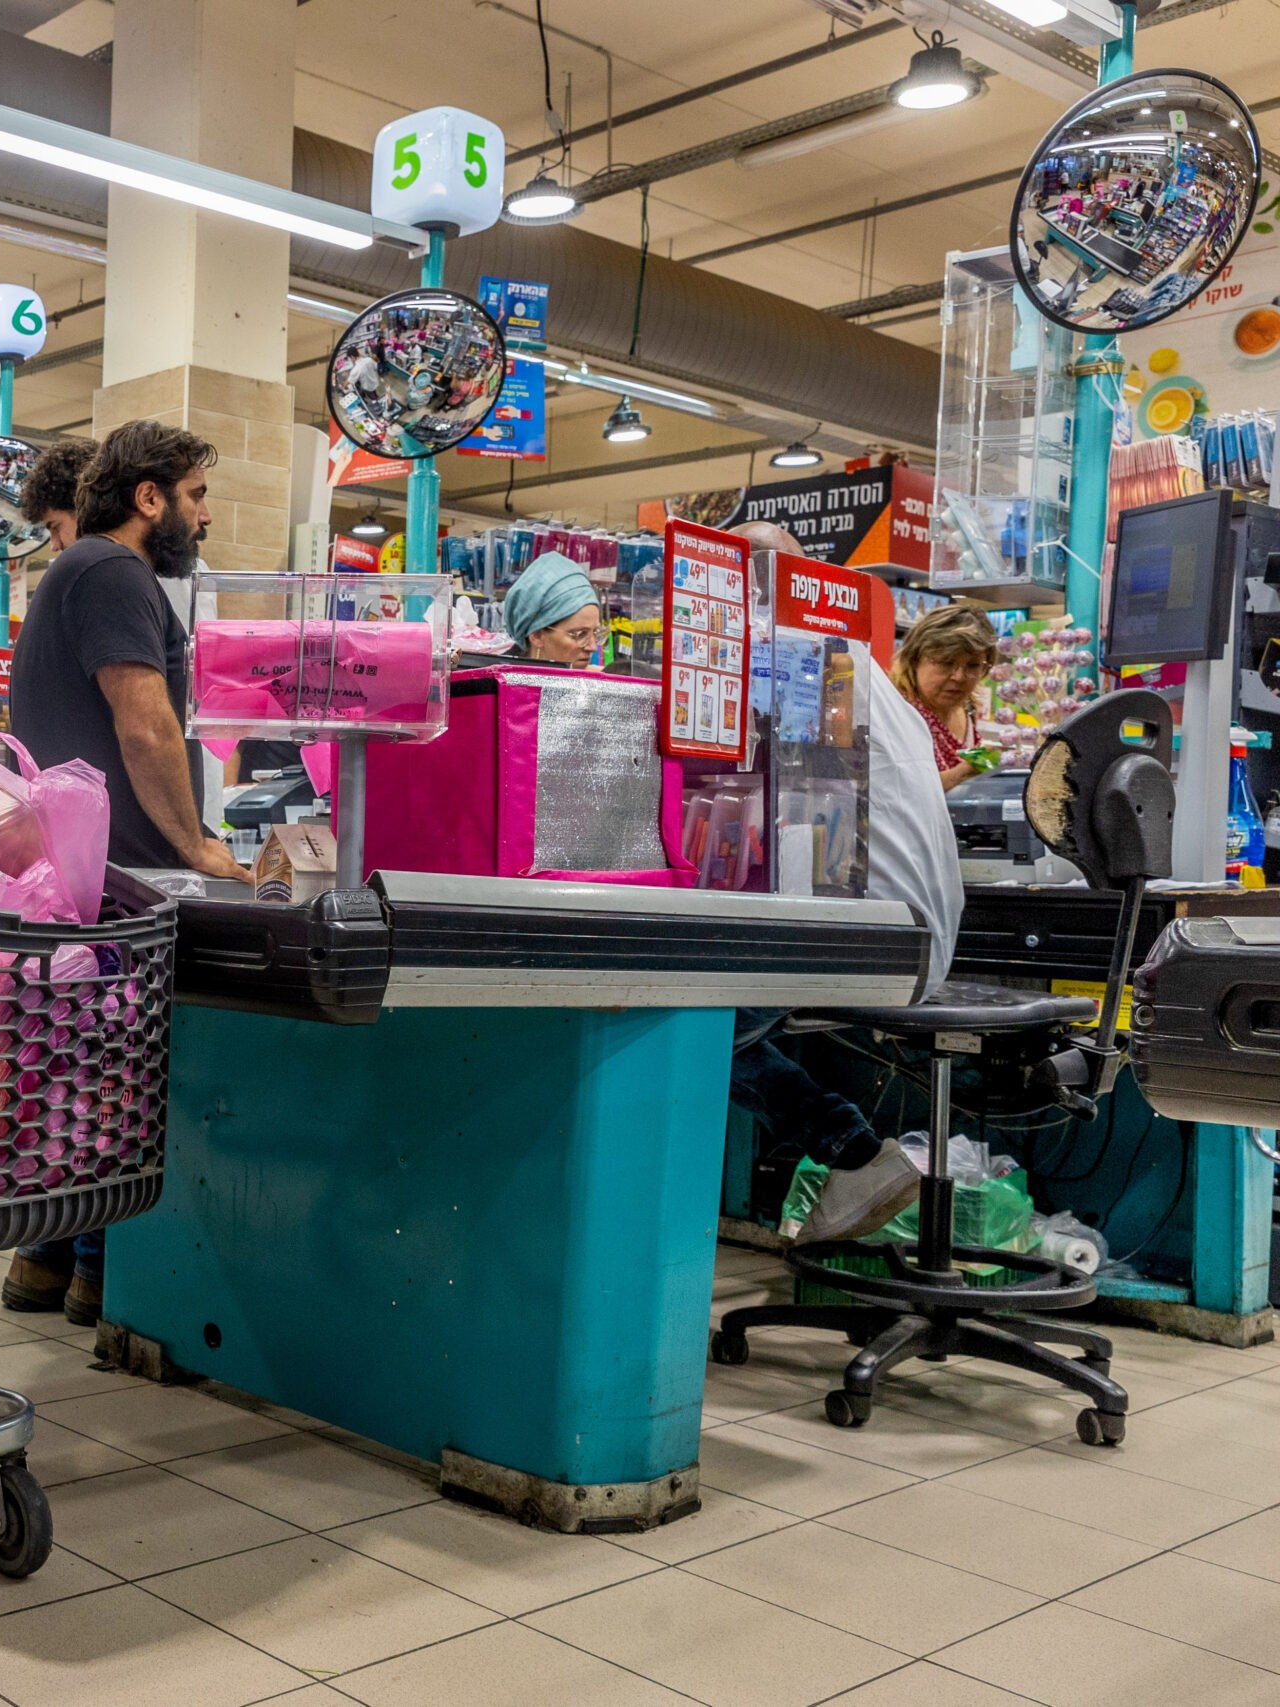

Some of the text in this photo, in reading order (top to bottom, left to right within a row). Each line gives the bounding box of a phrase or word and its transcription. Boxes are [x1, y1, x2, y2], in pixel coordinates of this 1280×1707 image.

[391, 132, 421, 190] 5
[463, 132, 487, 189] 5
[1205, 283, 1243, 305] שוקו
[12, 299, 43, 336] 6
[746, 482, 884, 521] הסדרה האסייתית
[794, 518, 817, 537] רמי
[819, 513, 854, 534] מבית
[790, 573, 859, 611] מבצעי קופה
